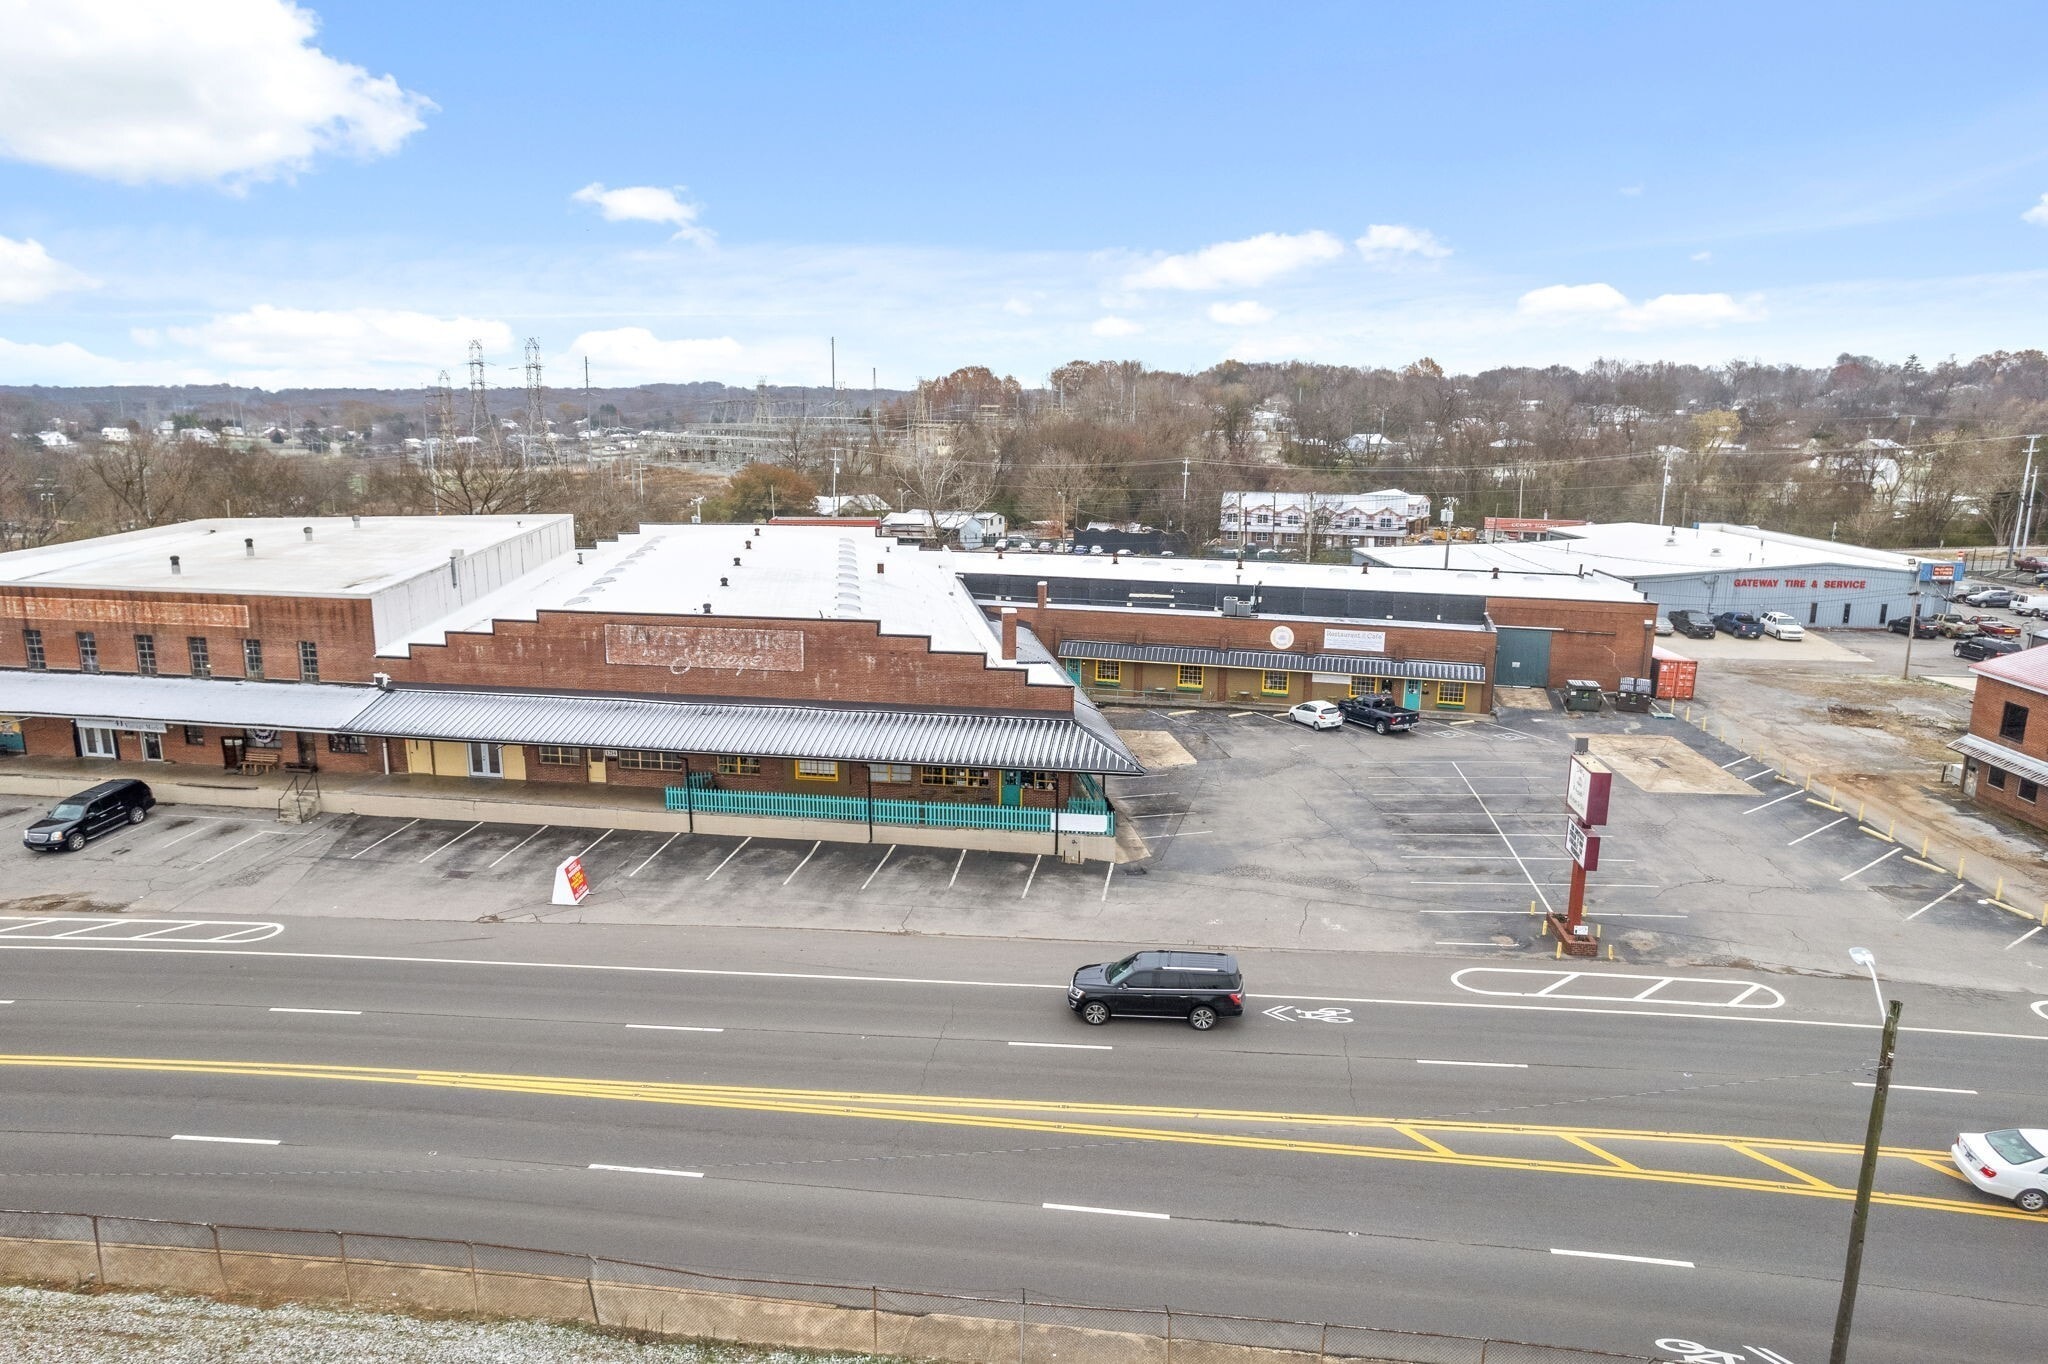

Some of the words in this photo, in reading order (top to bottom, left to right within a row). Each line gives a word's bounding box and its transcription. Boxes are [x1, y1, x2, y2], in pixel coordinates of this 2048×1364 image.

[1733, 579, 1779, 588] GATEWAY
[1784, 579, 1806, 588] TIRE
[1811, 580, 1818, 588] &
[1824, 580, 1866, 589] SERVICE
